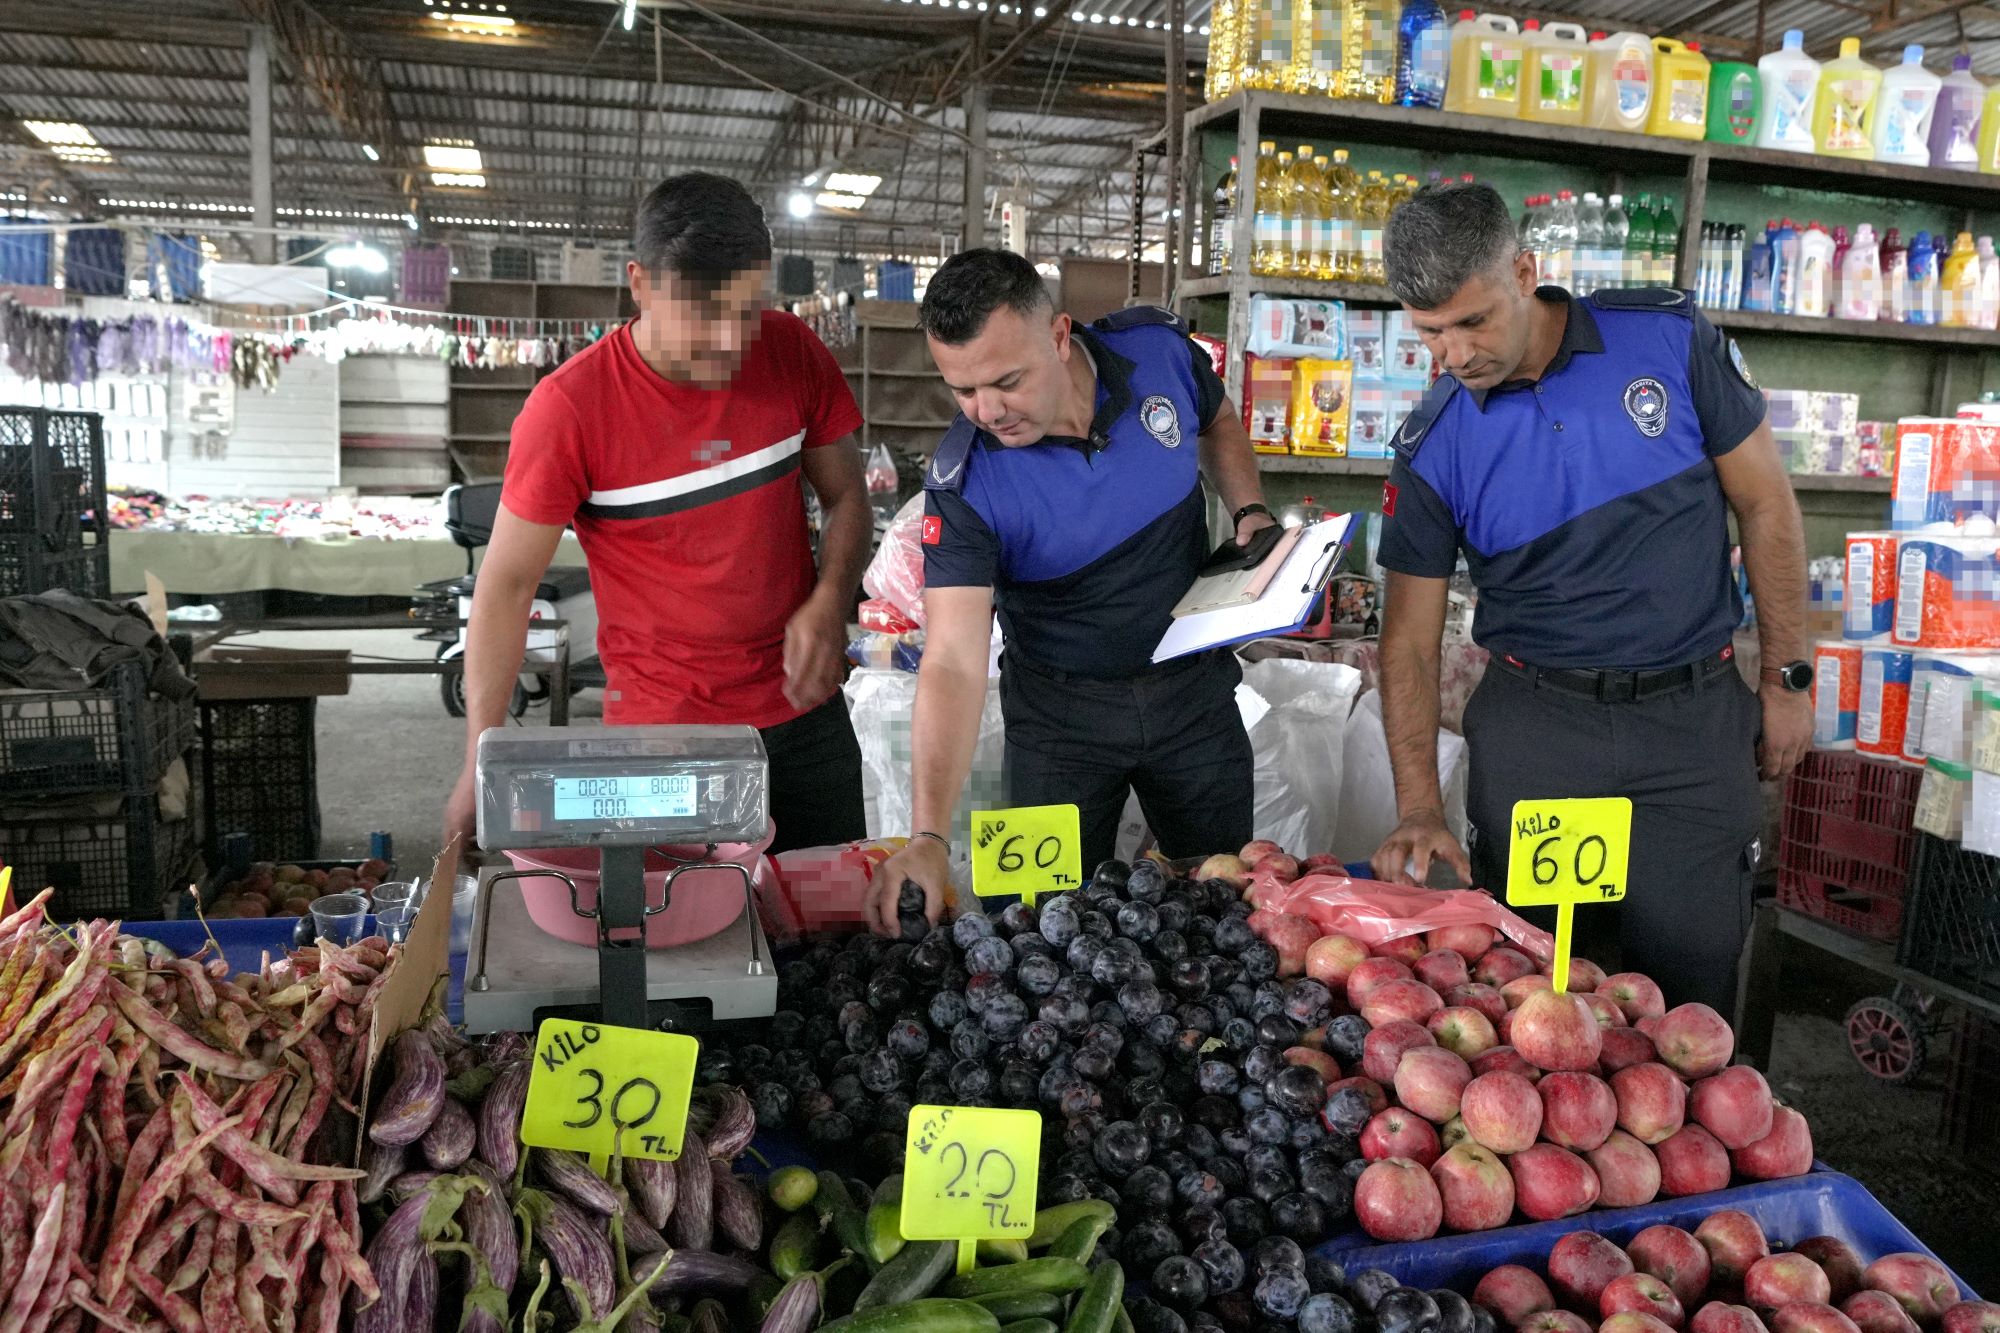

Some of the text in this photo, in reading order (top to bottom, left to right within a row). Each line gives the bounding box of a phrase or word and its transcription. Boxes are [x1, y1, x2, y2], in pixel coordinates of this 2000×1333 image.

[997, 834, 1062, 873] 60
[1532, 834, 1608, 886] 60
[562, 1067, 662, 1130] 30
[937, 1141, 1016, 1200] 20
